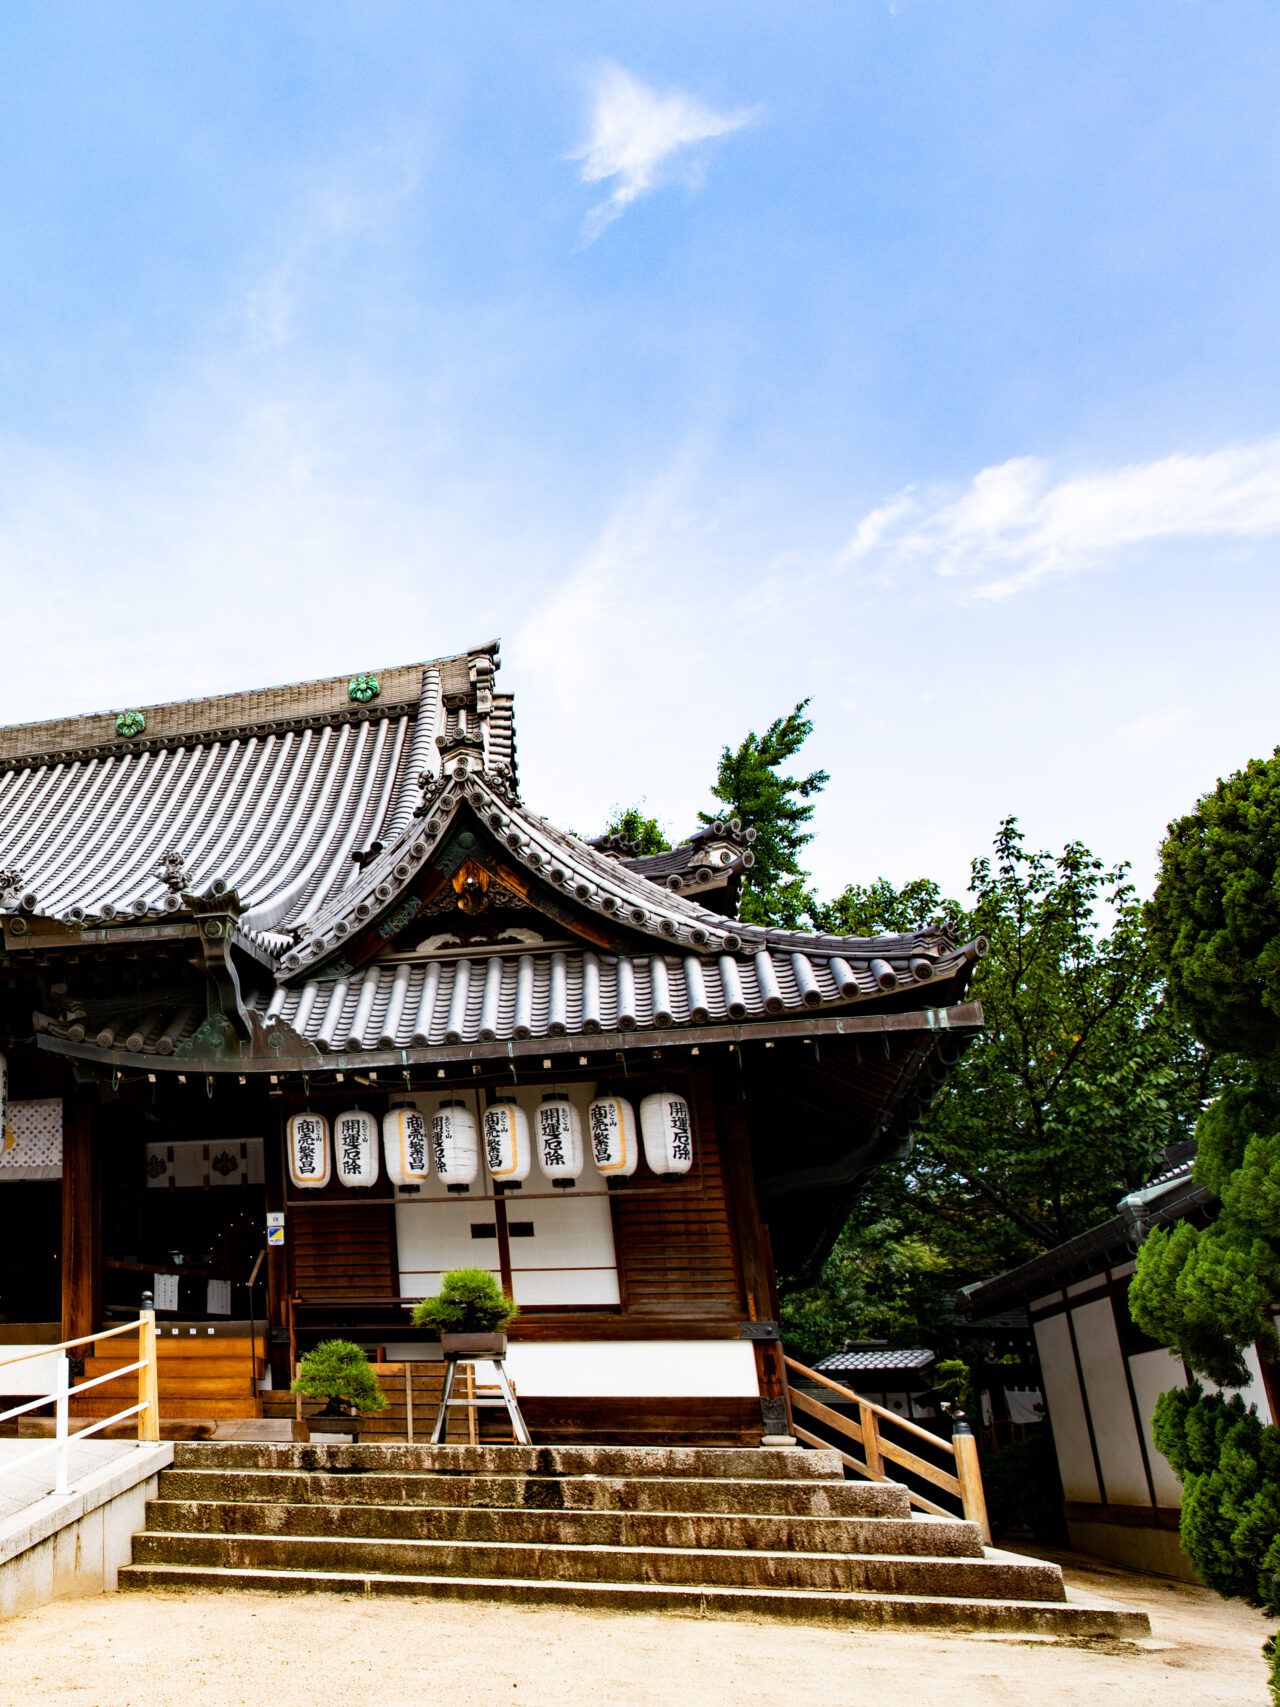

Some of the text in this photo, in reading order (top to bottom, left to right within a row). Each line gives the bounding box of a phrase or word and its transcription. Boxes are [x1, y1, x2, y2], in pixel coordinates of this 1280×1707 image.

[297, 1119, 316, 1174] 商売繁昌
[341, 1119, 362, 1175] 開運厄除
[407, 1114, 424, 1170] 商売繁昌
[432, 1116, 447, 1173] 開運厄除
[484, 1112, 502, 1169] 商売繁昌
[540, 1107, 565, 1166] 開運厄除
[590, 1104, 611, 1163] 商売繁昌
[668, 1101, 691, 1161] 開運厄除
